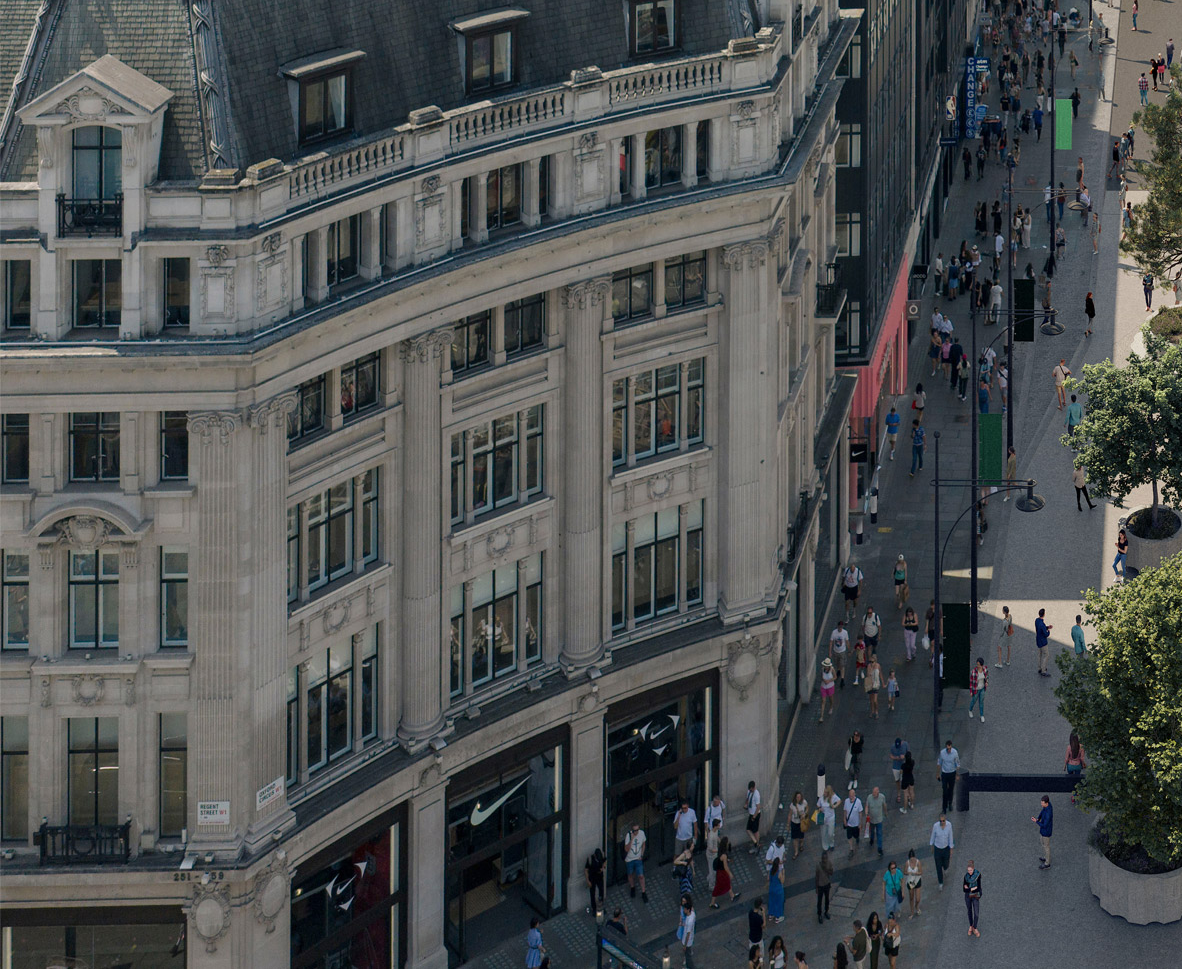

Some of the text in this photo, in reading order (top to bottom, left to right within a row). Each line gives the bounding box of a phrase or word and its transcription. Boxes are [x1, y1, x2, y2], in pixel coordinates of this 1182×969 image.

[967, 57, 975, 107] CHANGE
[259, 789, 275, 803] CIRCUS
[174, 872, 191, 881] 251
